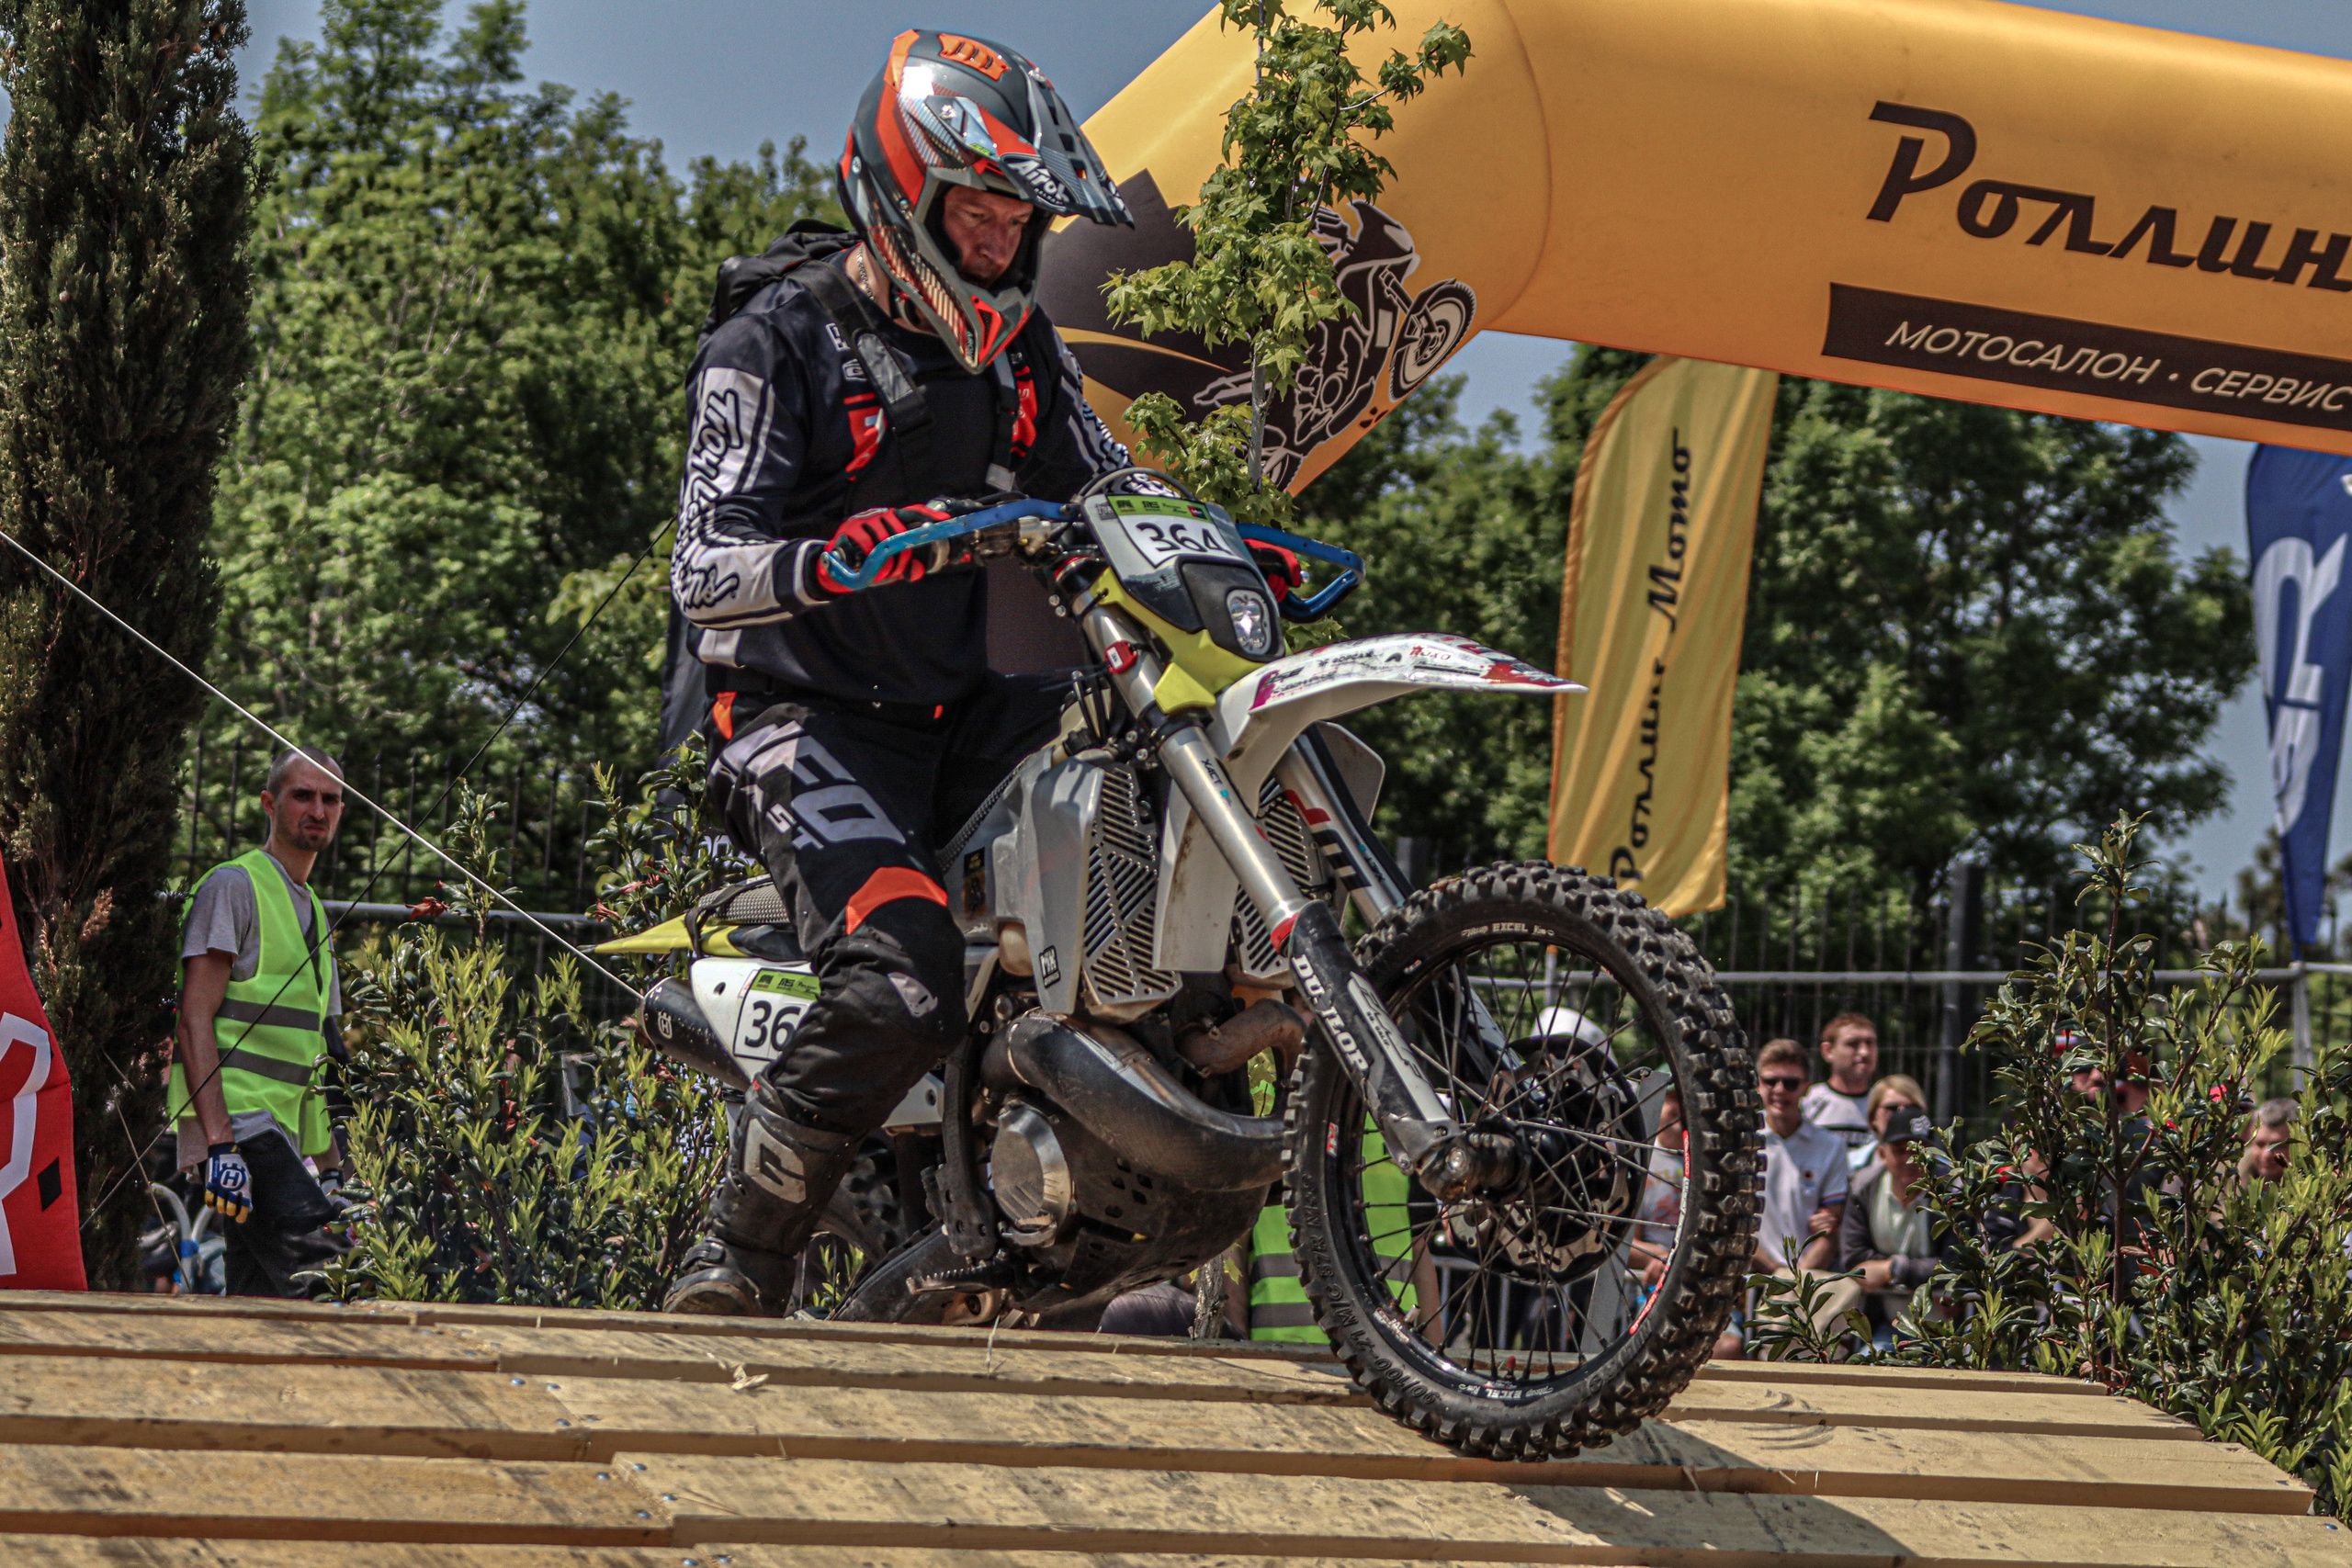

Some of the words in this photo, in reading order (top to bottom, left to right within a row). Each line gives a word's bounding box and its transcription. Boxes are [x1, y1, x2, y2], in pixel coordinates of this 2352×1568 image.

[1866, 99, 2352, 293] Роллин
[1884, 321, 2162, 384] МОТОСАЛОН
[2190, 367, 2352, 412] СЕРВИС
[692, 388, 743, 480] Troy
[1136, 522, 1234, 556] 364
[1645, 427, 1693, 634] Мото
[710, 758, 824, 850] PAST
[1492, 922, 1529, 932] EXCEL
[744, 999, 802, 1052] 36
[1326, 1283, 1359, 1328] M/C
[1485, 1388, 1521, 1400] EXCEL
